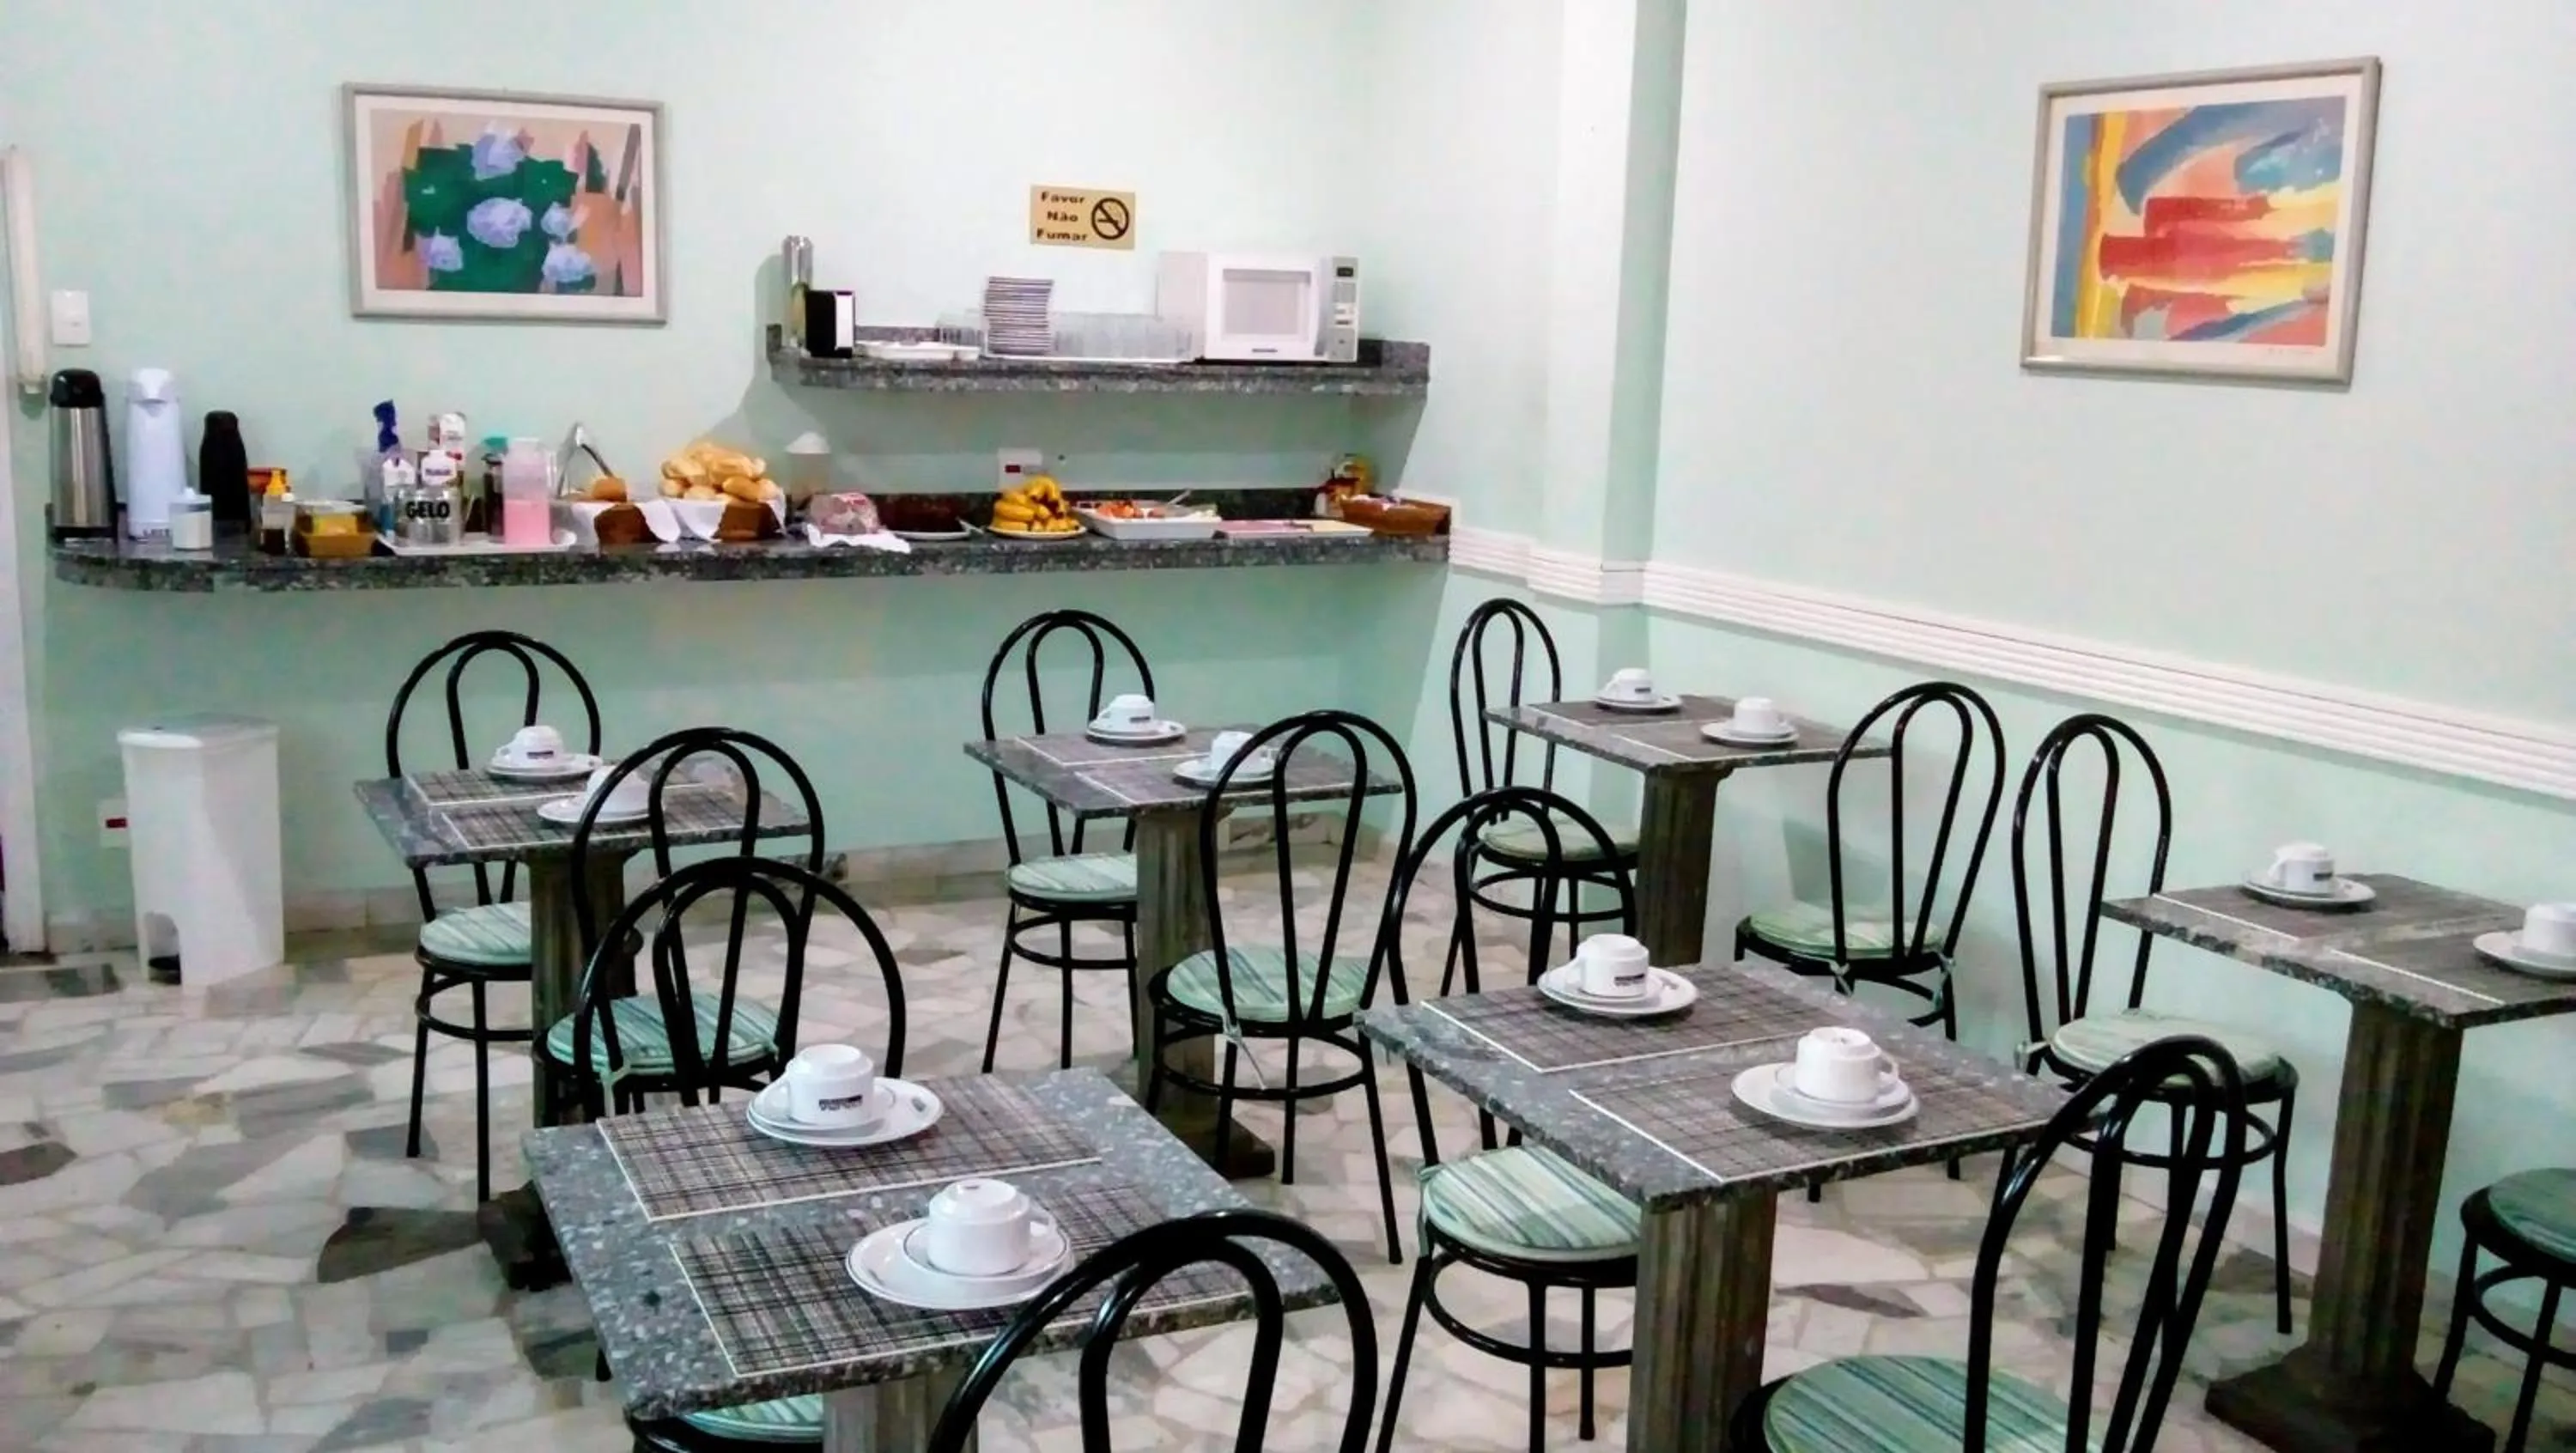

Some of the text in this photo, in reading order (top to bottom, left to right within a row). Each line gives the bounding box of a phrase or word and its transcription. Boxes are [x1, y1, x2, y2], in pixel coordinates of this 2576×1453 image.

[1041, 191, 1085, 204] Favor
[1047, 210, 1078, 222] Não
[1036, 228, 1088, 241] Fumar
[404, 501, 451, 519] GELO
